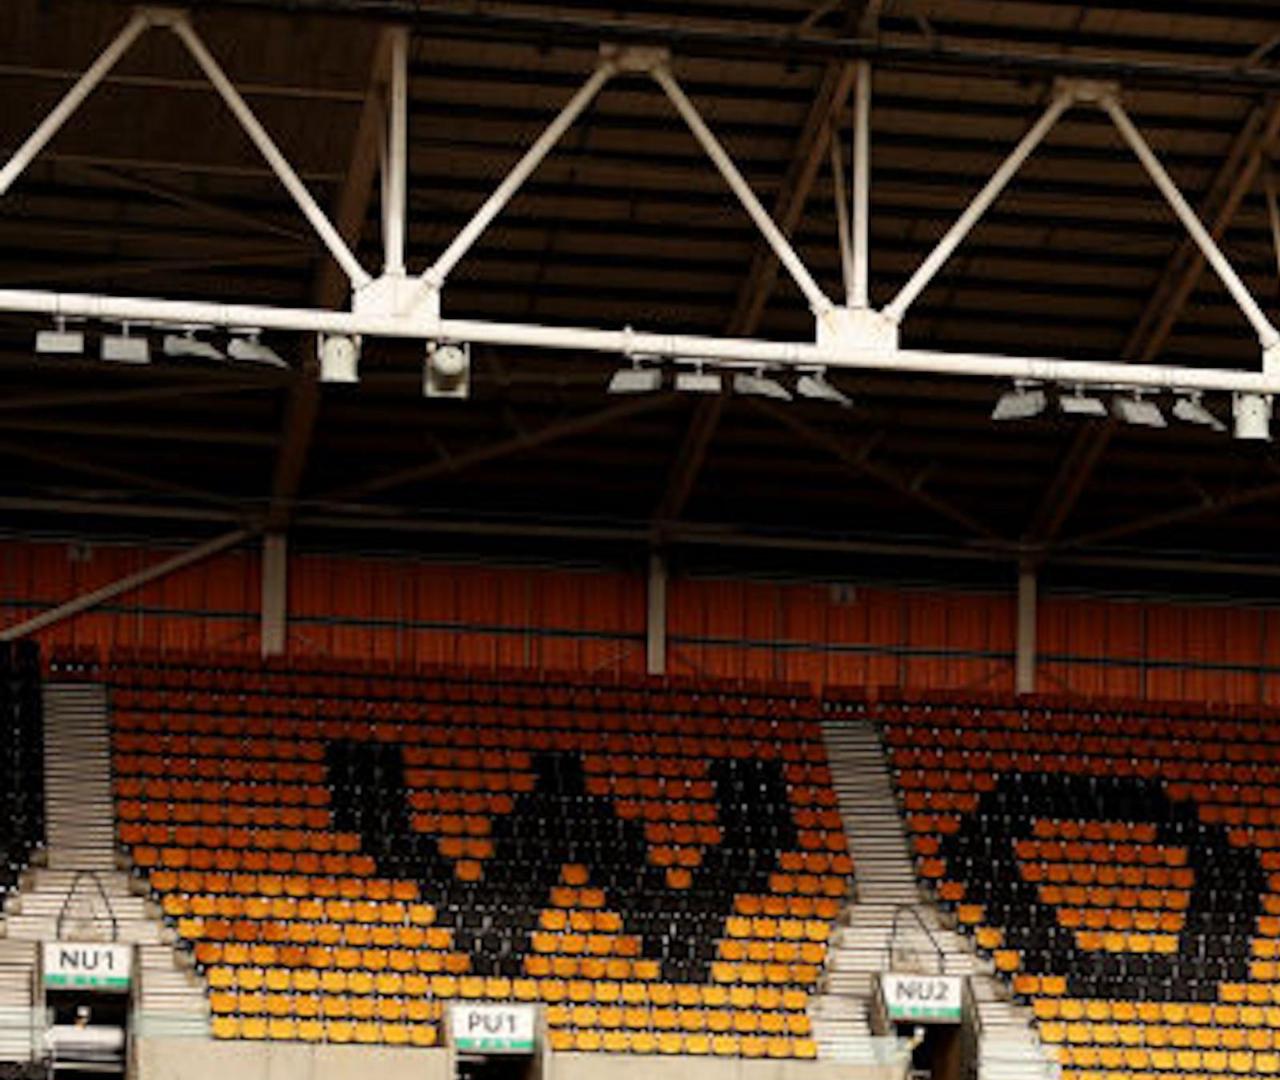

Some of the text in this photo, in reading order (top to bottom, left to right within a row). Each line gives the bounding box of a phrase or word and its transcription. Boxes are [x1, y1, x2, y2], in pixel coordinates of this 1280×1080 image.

[59, 951, 114, 969] NU1
[896, 981, 948, 999] NU2
[468, 1013, 516, 1032] PU1
